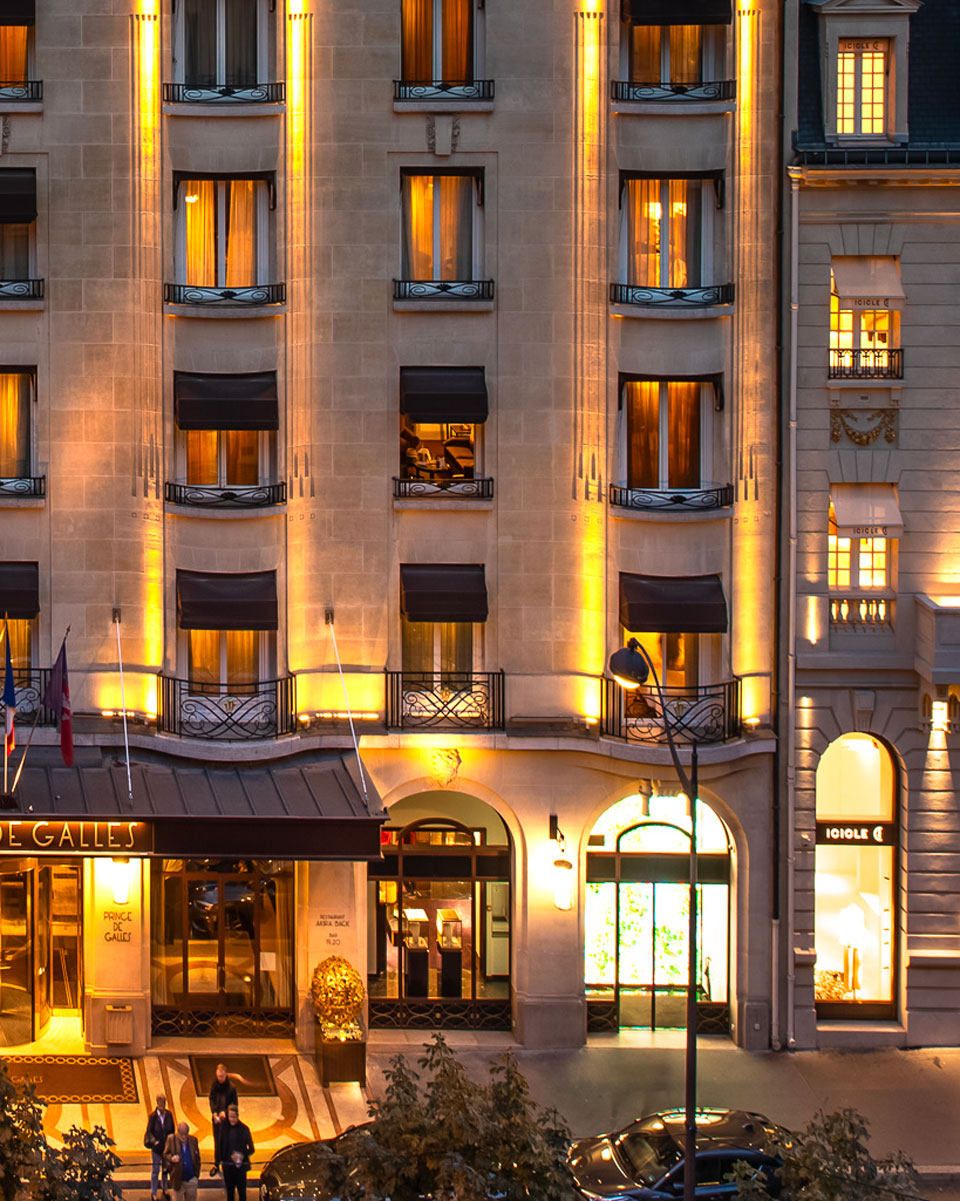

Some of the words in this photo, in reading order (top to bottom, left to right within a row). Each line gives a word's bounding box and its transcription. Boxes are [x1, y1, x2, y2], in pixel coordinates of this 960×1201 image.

[32, 821, 138, 848] GALLES
[826, 828, 869, 839] ICICLE
[103, 911, 132, 921] PRINCE
[113, 922, 122, 931] DE
[104, 932, 131, 942] GALLES
